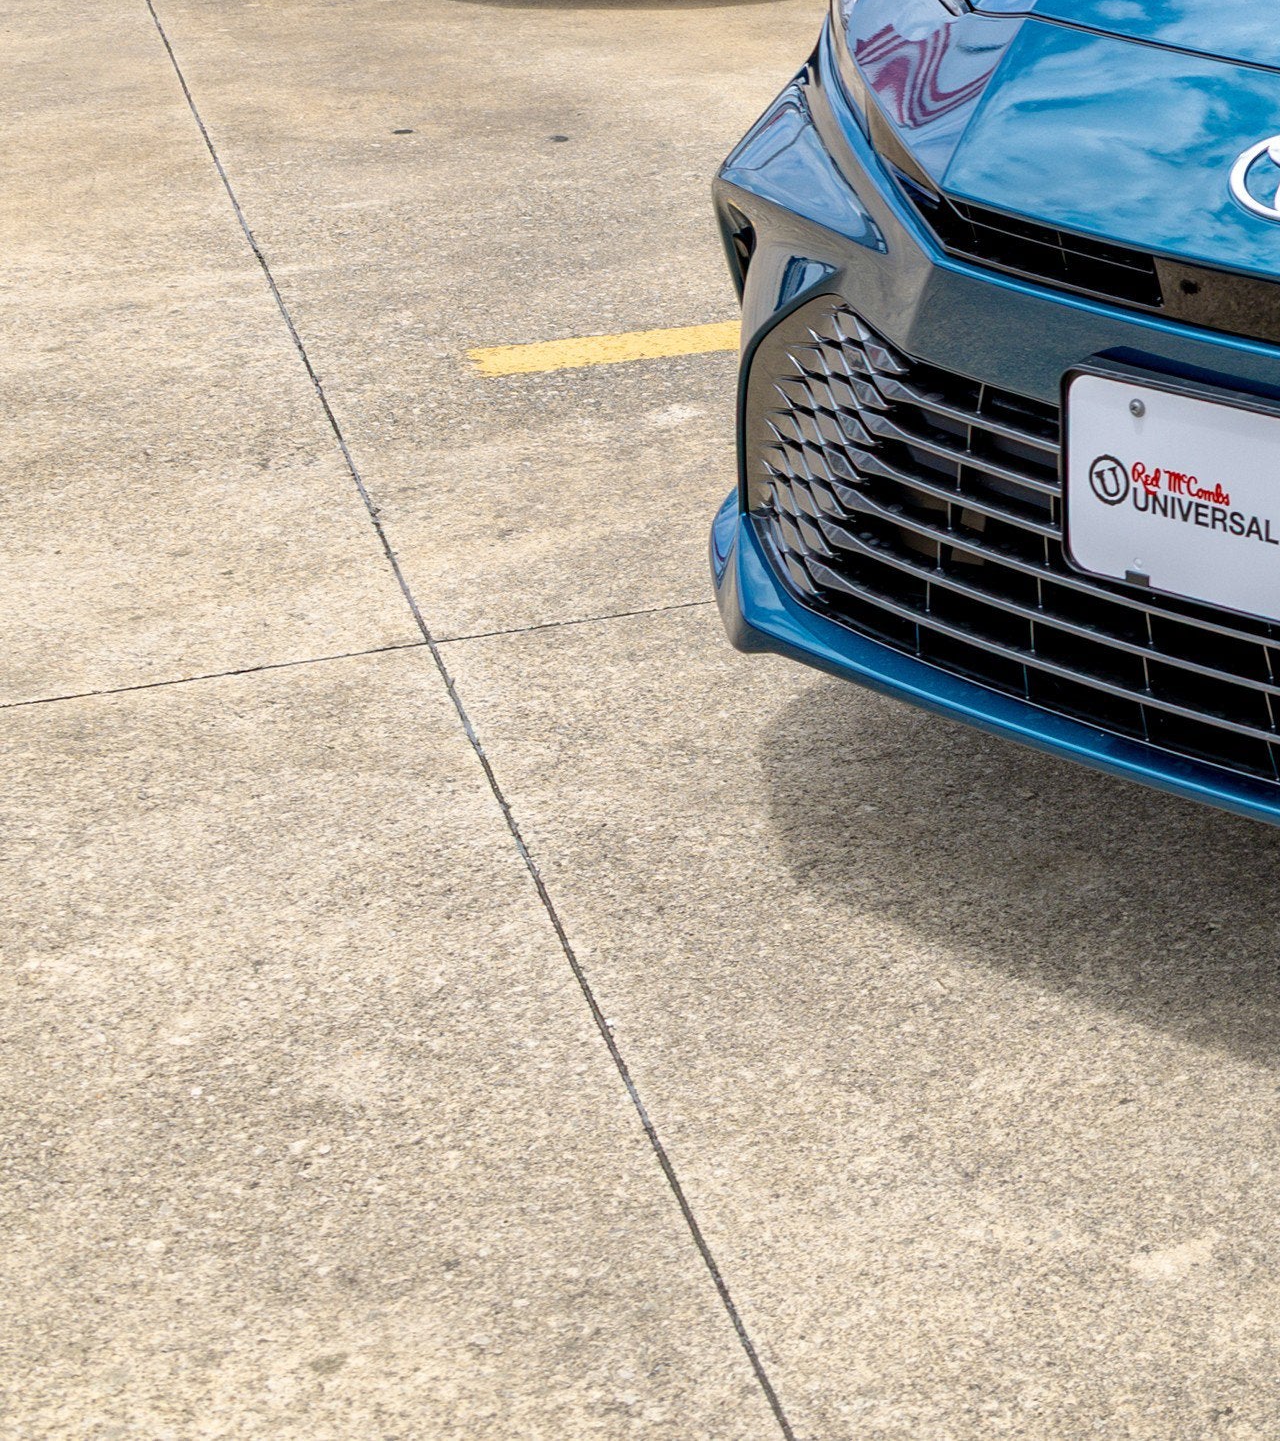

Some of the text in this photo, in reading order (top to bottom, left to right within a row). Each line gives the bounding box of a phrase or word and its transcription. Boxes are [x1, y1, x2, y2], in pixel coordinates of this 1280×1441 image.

[1132, 462, 1230, 506] Red McCombs
[1133, 487, 1279, 545] UNIVERSAL
